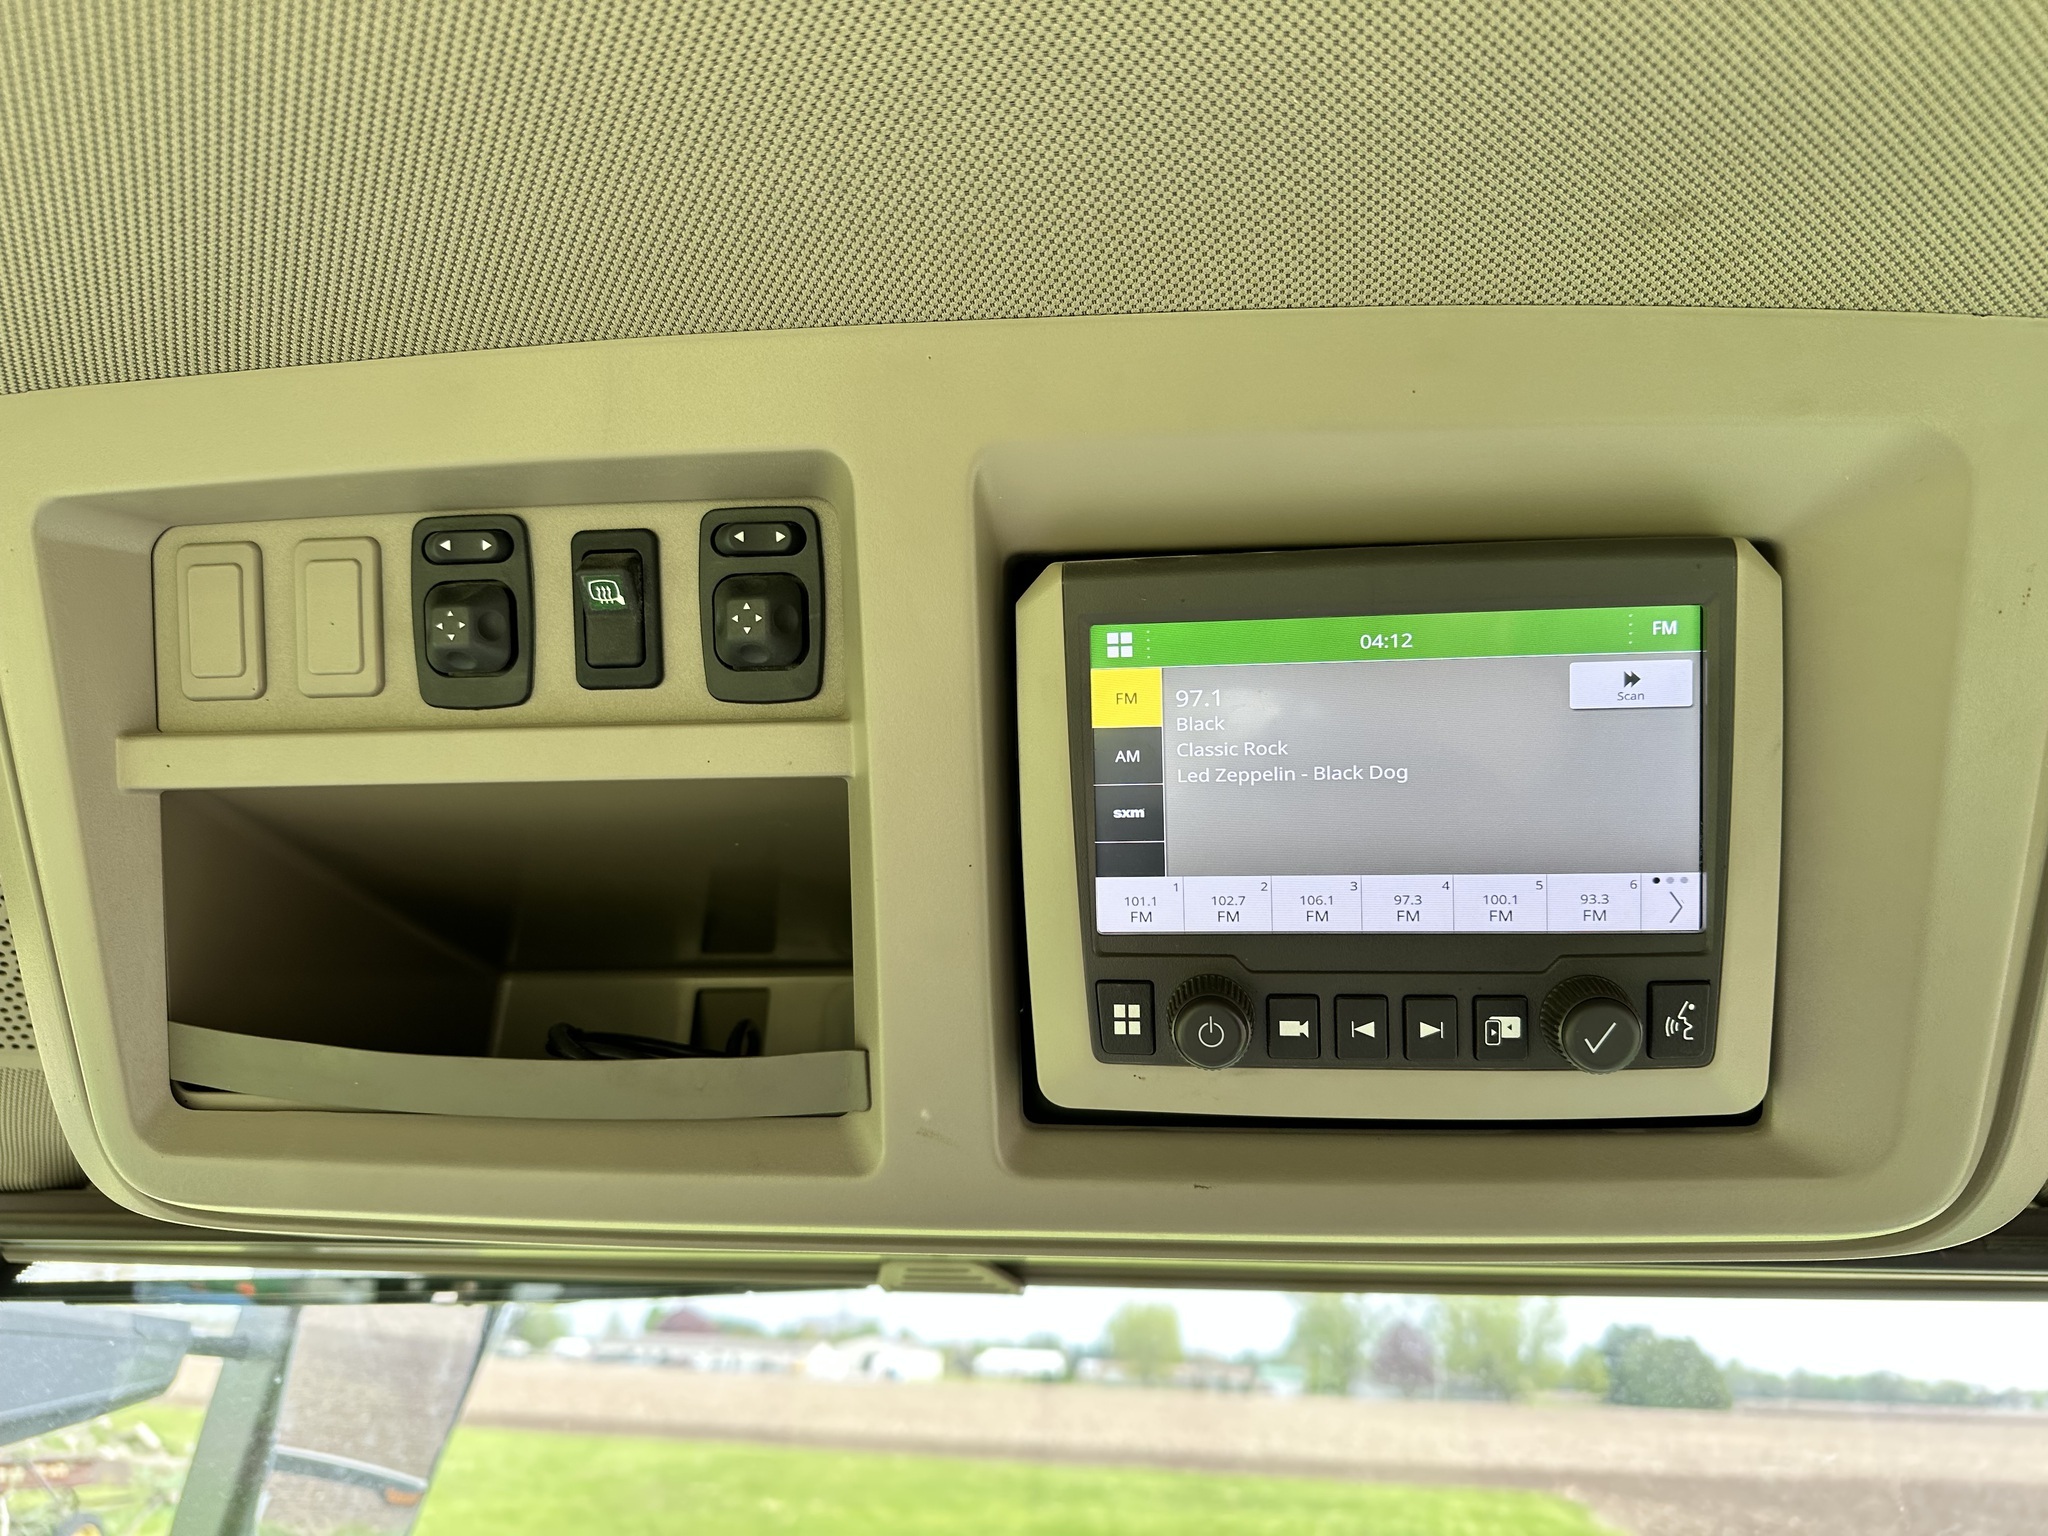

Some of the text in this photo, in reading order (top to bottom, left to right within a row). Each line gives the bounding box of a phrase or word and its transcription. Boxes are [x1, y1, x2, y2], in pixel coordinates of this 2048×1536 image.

[1652, 620, 1678, 636] FM
[1359, 632, 1413, 650] 04:12
[1116, 692, 1138, 705] FM
[1175, 688, 1220, 708] 97.1
[1617, 691, 1645, 701] Scan
[1176, 715, 1225, 732] Black
[1176, 740, 1289, 757] Classic Rock
[1114, 749, 1140, 763] AM
[1177, 767, 1210, 784] Led
[1214, 766, 1296, 787] Zeppelin
[1313, 764, 1363, 781] Black
[1369, 765, 1408, 784] Dog
[1173, 882, 1179, 892] 1
[1260, 881, 1268, 892] 2
[1350, 881, 1358, 892] 3
[1441, 881, 1450, 891] 4
[1535, 880, 1544, 891] 5
[1629, 879, 1638, 890] 6
[1124, 896, 1157, 907] 101.1
[1211, 895, 1246, 906] 102.7
[1300, 895, 1333, 906] 106.1
[1393, 894, 1423, 906] 97.3
[1483, 894, 1517, 905] 100.1
[1580, 893, 1610, 905] 93.3
[1130, 911, 1153, 923] FM
[1217, 910, 1240, 923] FM
[1306, 910, 1329, 922] FM
[1397, 910, 1420, 922] FM
[1489, 909, 1513, 922] FM
[1583, 909, 1607, 922] FM
